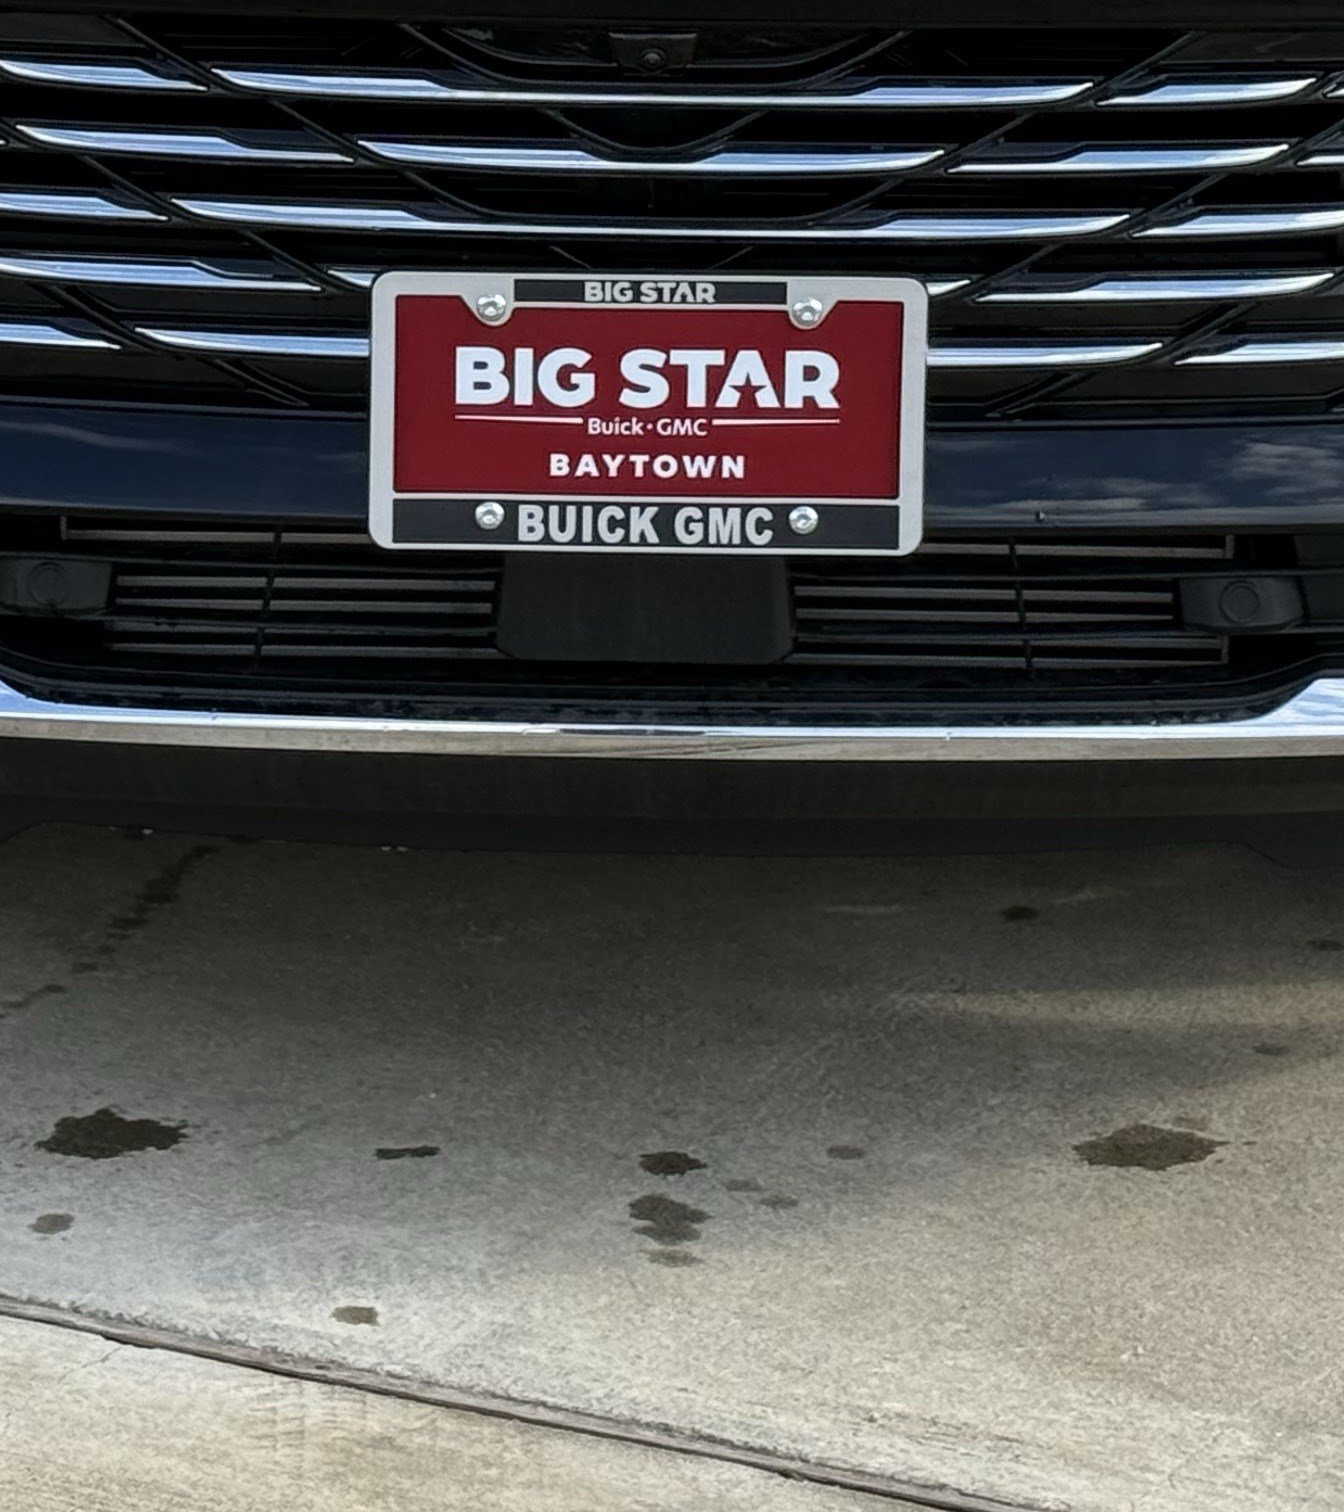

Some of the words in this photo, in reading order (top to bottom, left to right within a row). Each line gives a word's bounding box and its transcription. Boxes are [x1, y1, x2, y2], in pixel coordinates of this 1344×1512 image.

[584, 281, 632, 303] BIG
[640, 282, 716, 304] STAR
[455, 346, 596, 407] BIG
[619, 348, 840, 409] STAR
[587, 416, 644, 436] Buick
[656, 418, 708, 436] GMC
[549, 453, 745, 479] BAYTOWN
[517, 504, 660, 544] BUICK
[674, 507, 774, 547] GMC
